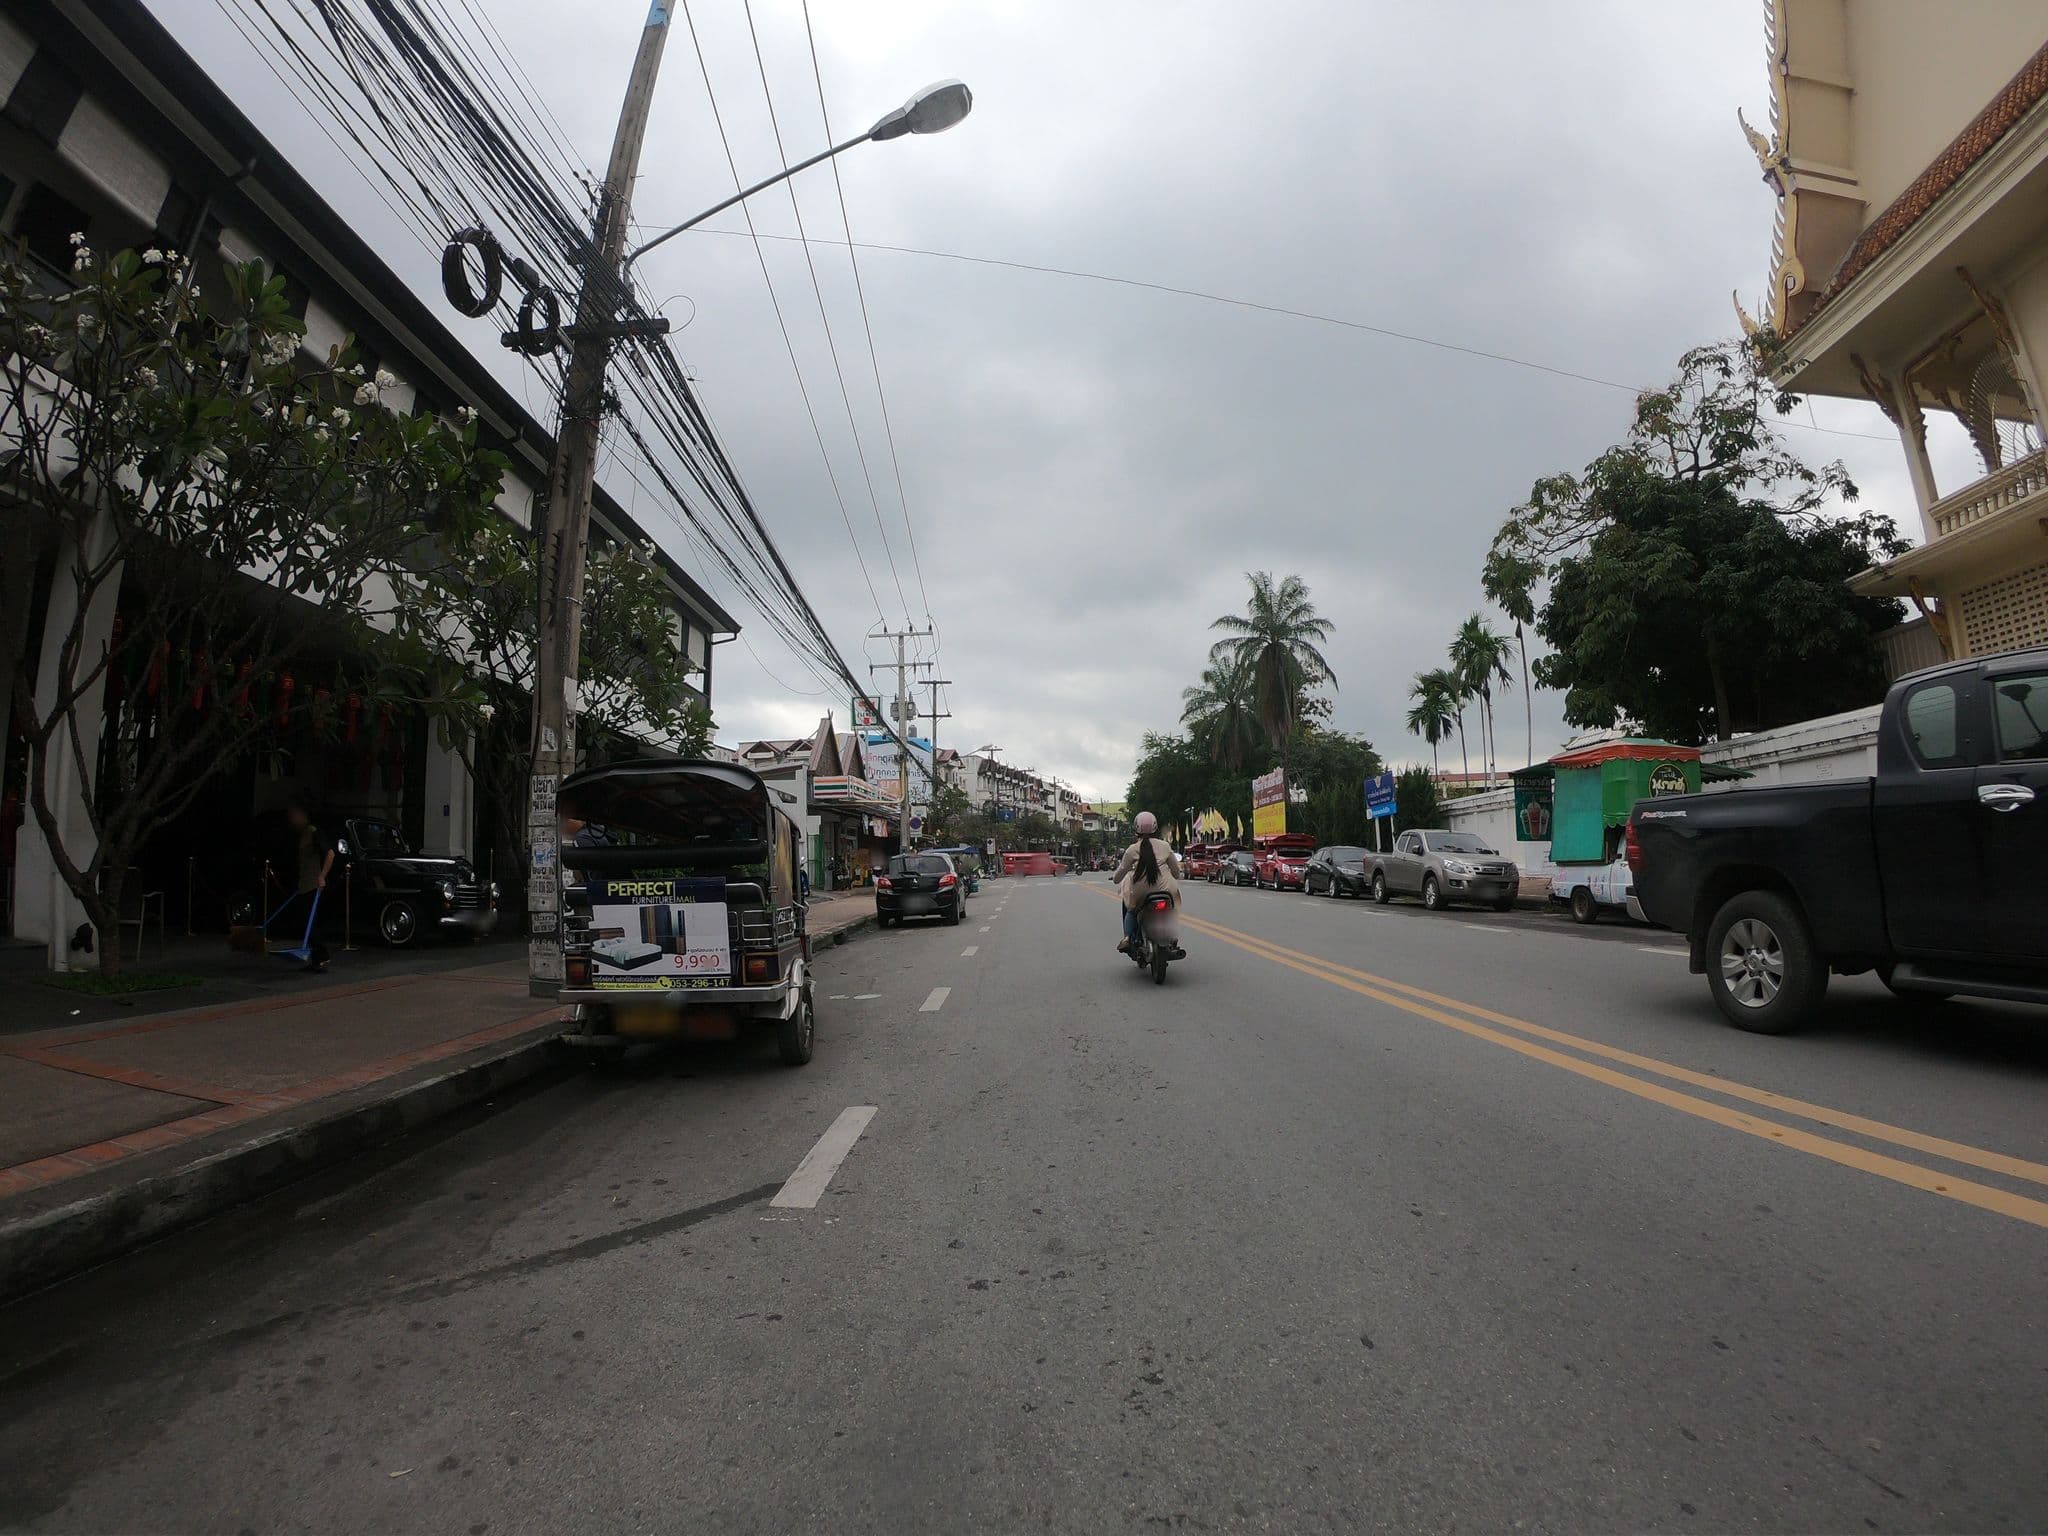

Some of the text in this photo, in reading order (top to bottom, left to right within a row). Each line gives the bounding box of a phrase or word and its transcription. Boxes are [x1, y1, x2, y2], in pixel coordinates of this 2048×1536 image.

[607, 881, 673, 897] PERFECT
[631, 895, 696, 904] FURNITURE MALL
